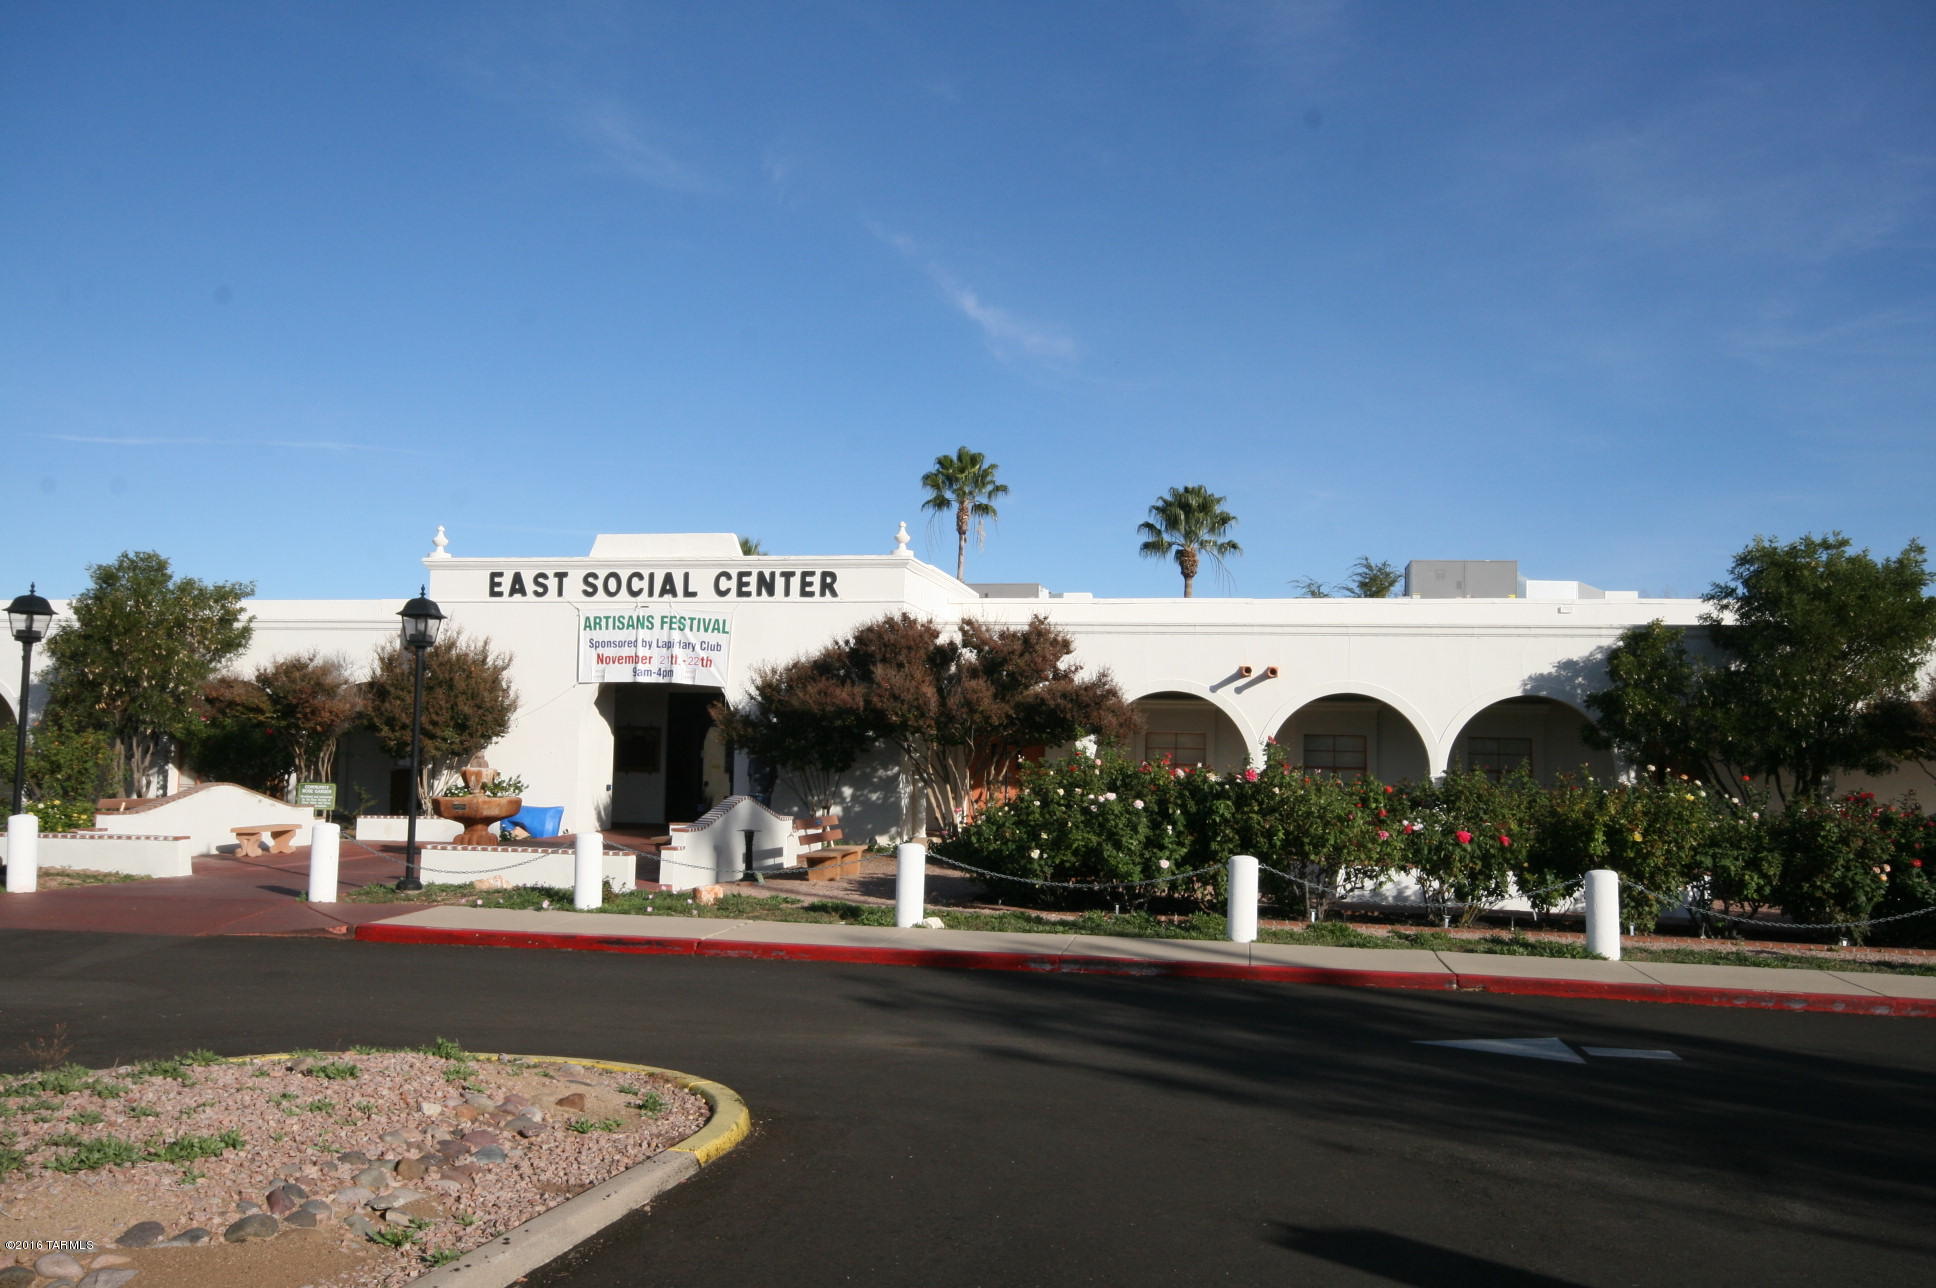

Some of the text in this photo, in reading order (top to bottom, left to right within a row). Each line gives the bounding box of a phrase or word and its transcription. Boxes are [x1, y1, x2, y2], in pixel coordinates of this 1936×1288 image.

[488, 570, 840, 598] EAST SOCIAL CENTER
[583, 615, 730, 635] ARTISANS FESTIVAL
[588, 638, 638, 650] Sponsored
[641, 638, 653, 650] by
[700, 641, 722, 652] Club
[596, 653, 653, 665] November
[632, 666, 674, 679] 9am-4pm
